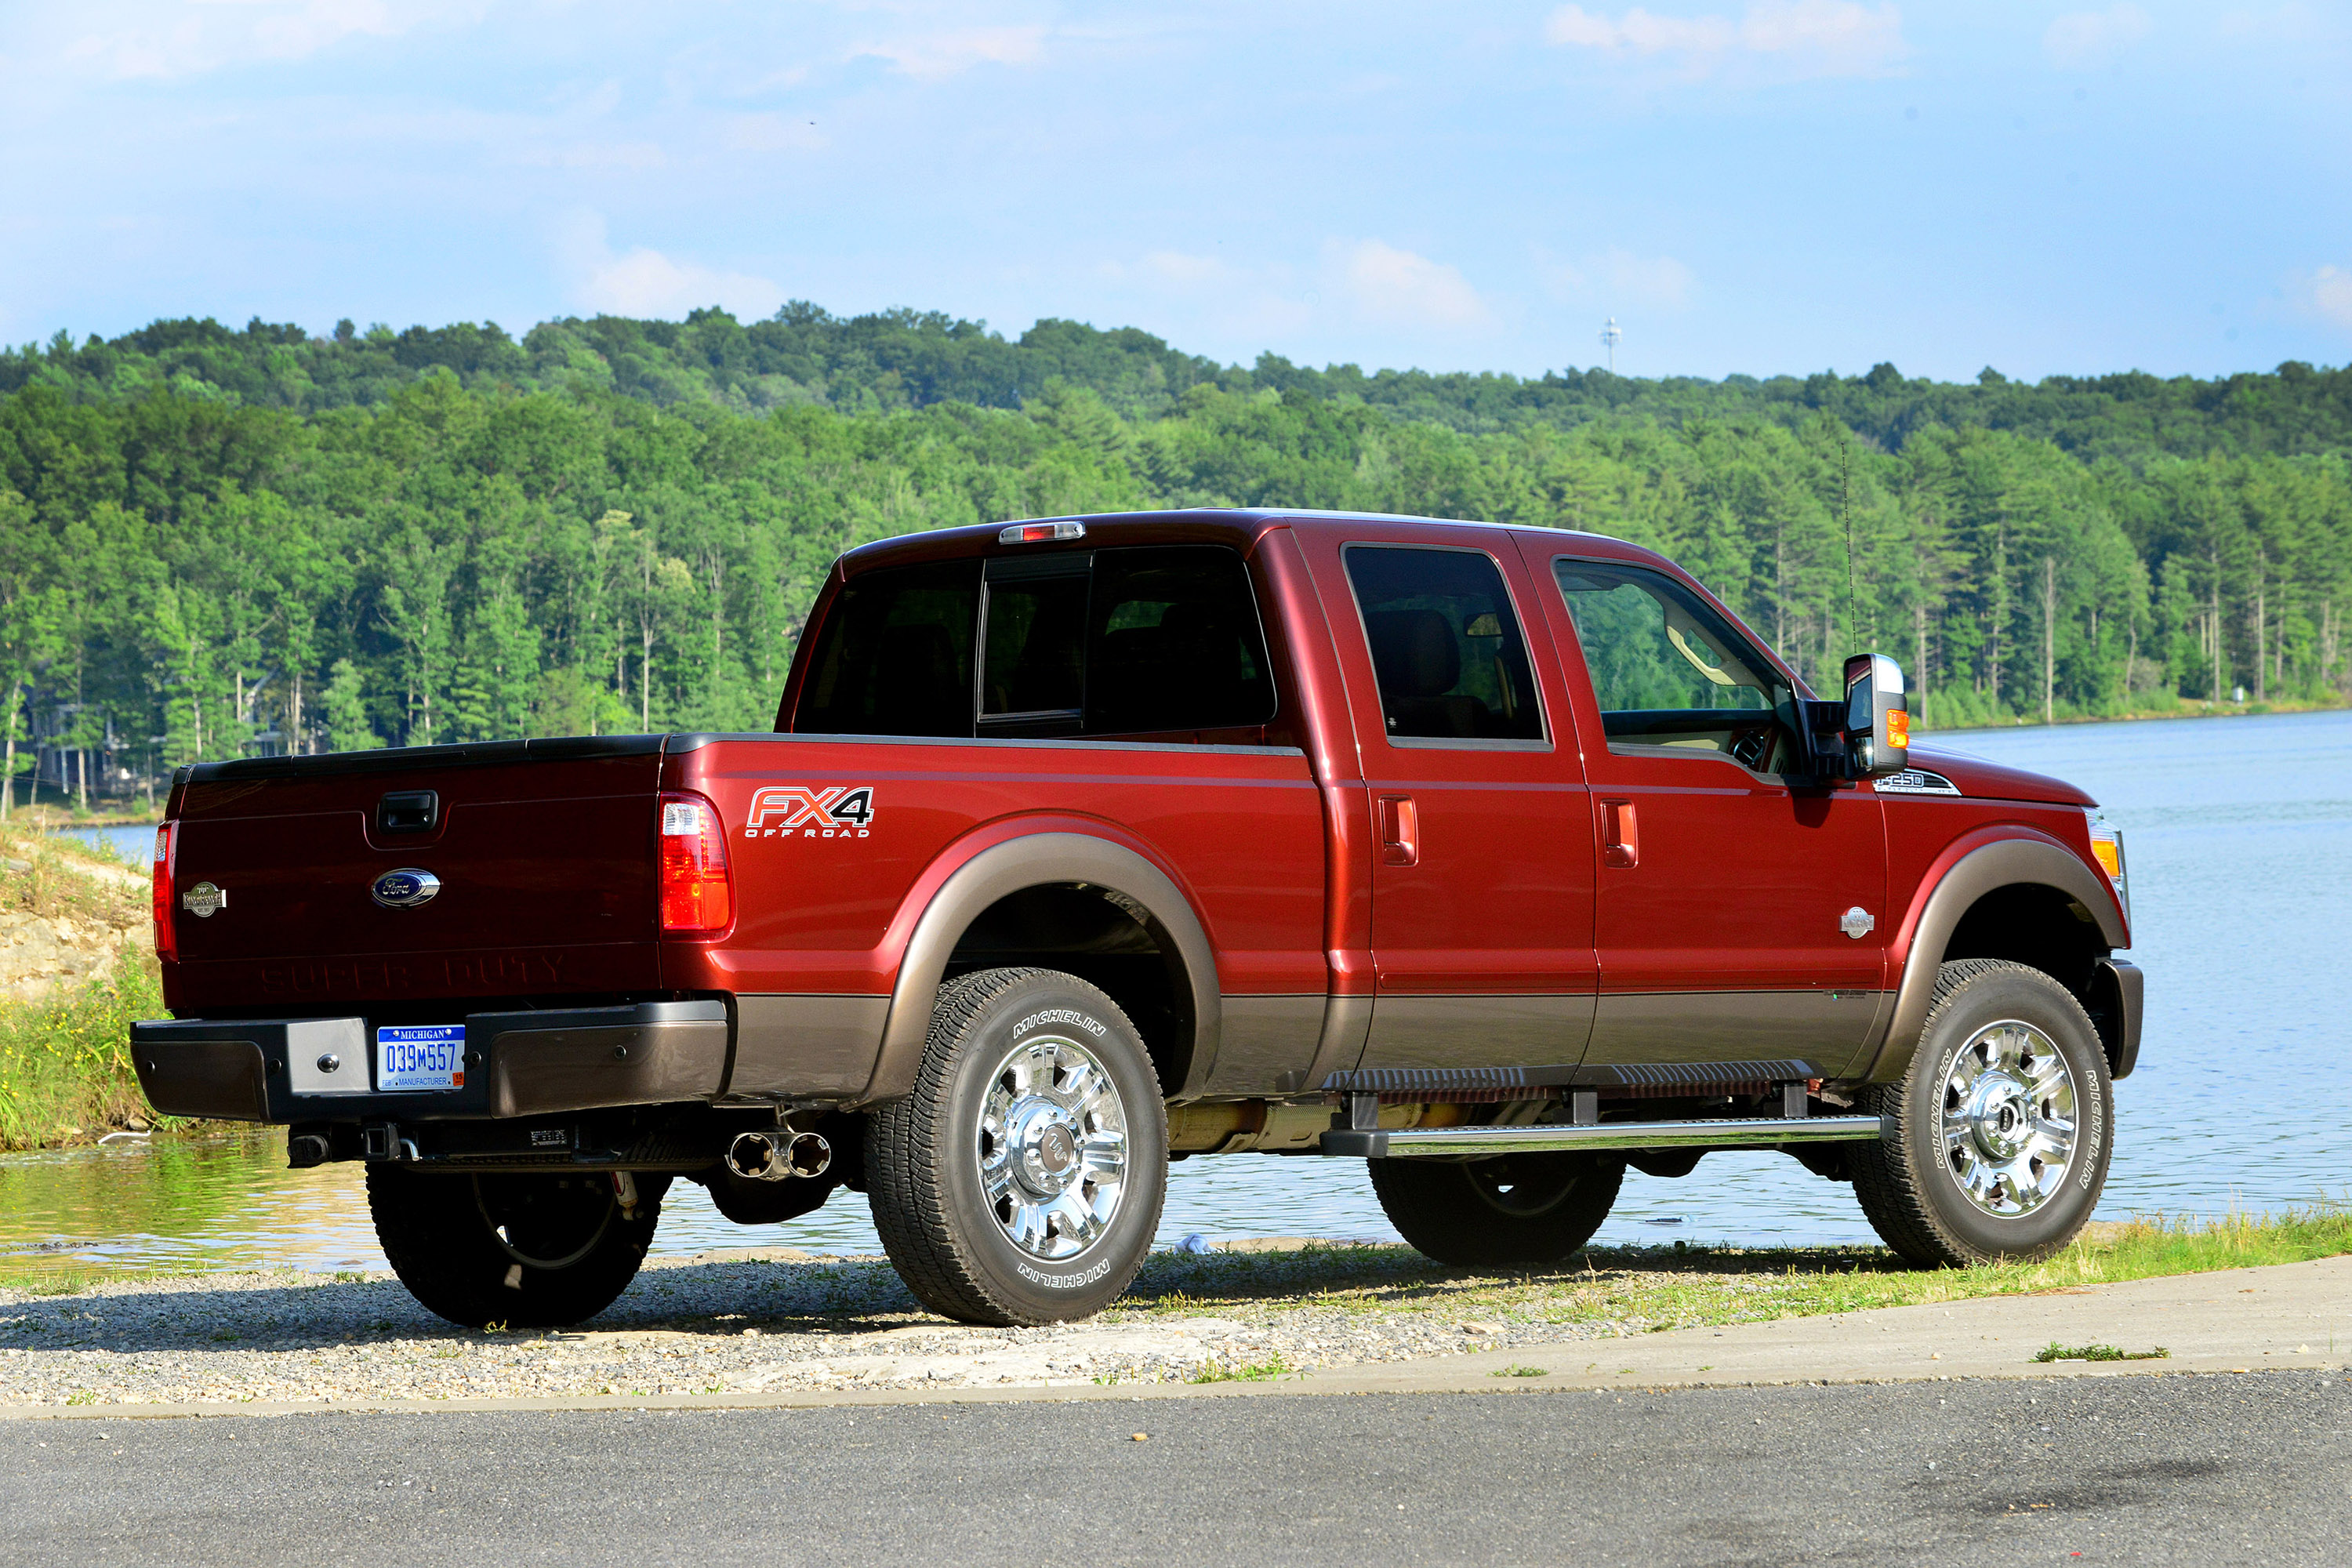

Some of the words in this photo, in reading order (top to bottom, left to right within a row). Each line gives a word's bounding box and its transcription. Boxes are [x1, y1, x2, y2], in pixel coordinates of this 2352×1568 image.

[746, 786, 874, 828] FX4
[745, 829, 793, 838] OFF
[804, 829, 869, 838] ROAD
[184, 895, 199, 906] KING
[383, 877, 410, 895] Ford
[260, 960, 409, 993] SUPER
[444, 953, 565, 987] DUTY
[401, 1029, 445, 1040] MICHIGAN
[1013, 1009, 1107, 1040] MICHELIN
[387, 1044, 456, 1073] 039M557
[399, 1077, 447, 1086] MANUFACTURER
[1931, 1047, 1953, 1169] MICHELIN
[2078, 1069, 2102, 1189] MICHELIN
[1017, 1258, 1111, 1289] MICHELIN
